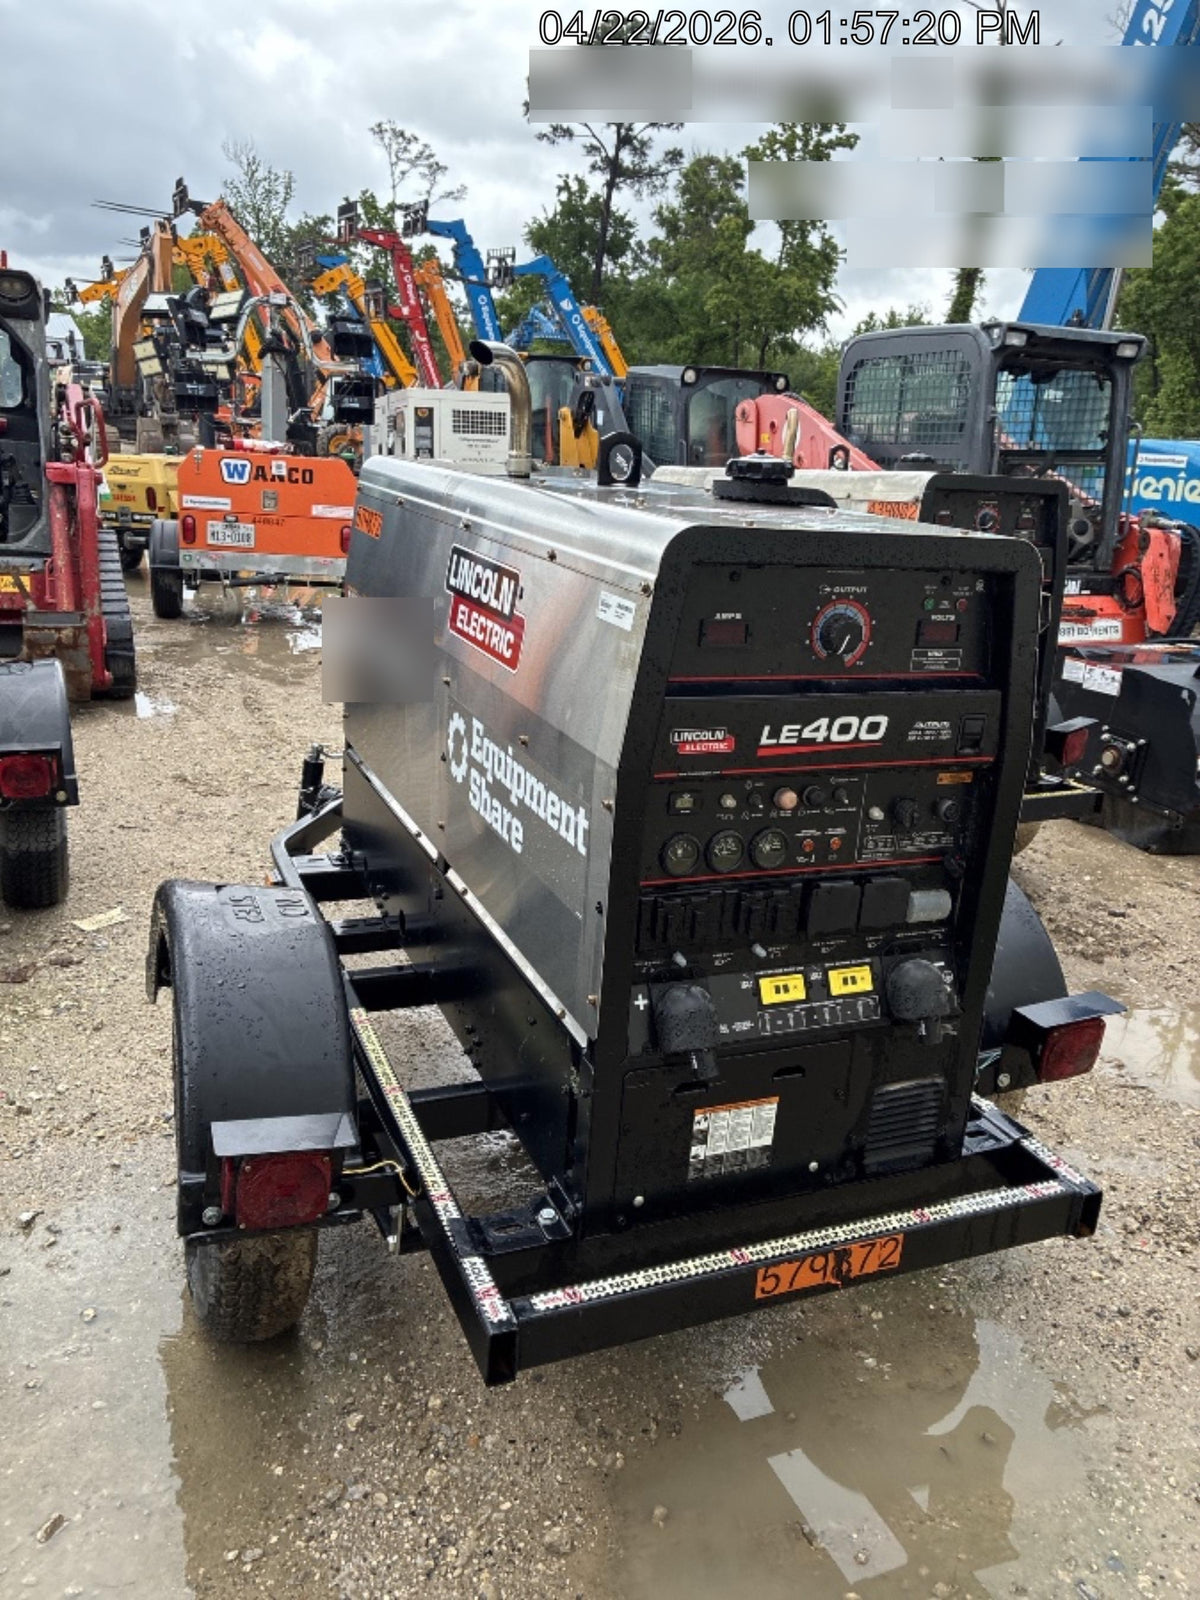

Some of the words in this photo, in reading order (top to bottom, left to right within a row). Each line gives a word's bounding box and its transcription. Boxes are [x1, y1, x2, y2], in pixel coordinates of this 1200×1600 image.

[448, 553, 516, 617] LINCOLN
[832, 585, 870, 594] OUTPUT
[455, 603, 514, 660] ELECTRIC
[673, 730, 725, 743] LINCOLN
[685, 742, 728, 751] ELECTRIC
[759, 714, 889, 746] LE400
[468, 770, 524, 855] Share
[470, 716, 589, 856] Equipment
[583, 1283, 608, 1297] DO
[607, 1276, 638, 1292] NOT
[641, 1264, 692, 1284] STAND
[692, 1254, 733, 1272] HERE
[749, 1246, 769, 1258] NE
[770, 1240, 798, 1254] PAS
[799, 1230, 841, 1247] TENEZ
[841, 1218, 895, 1237] DEBOUT
